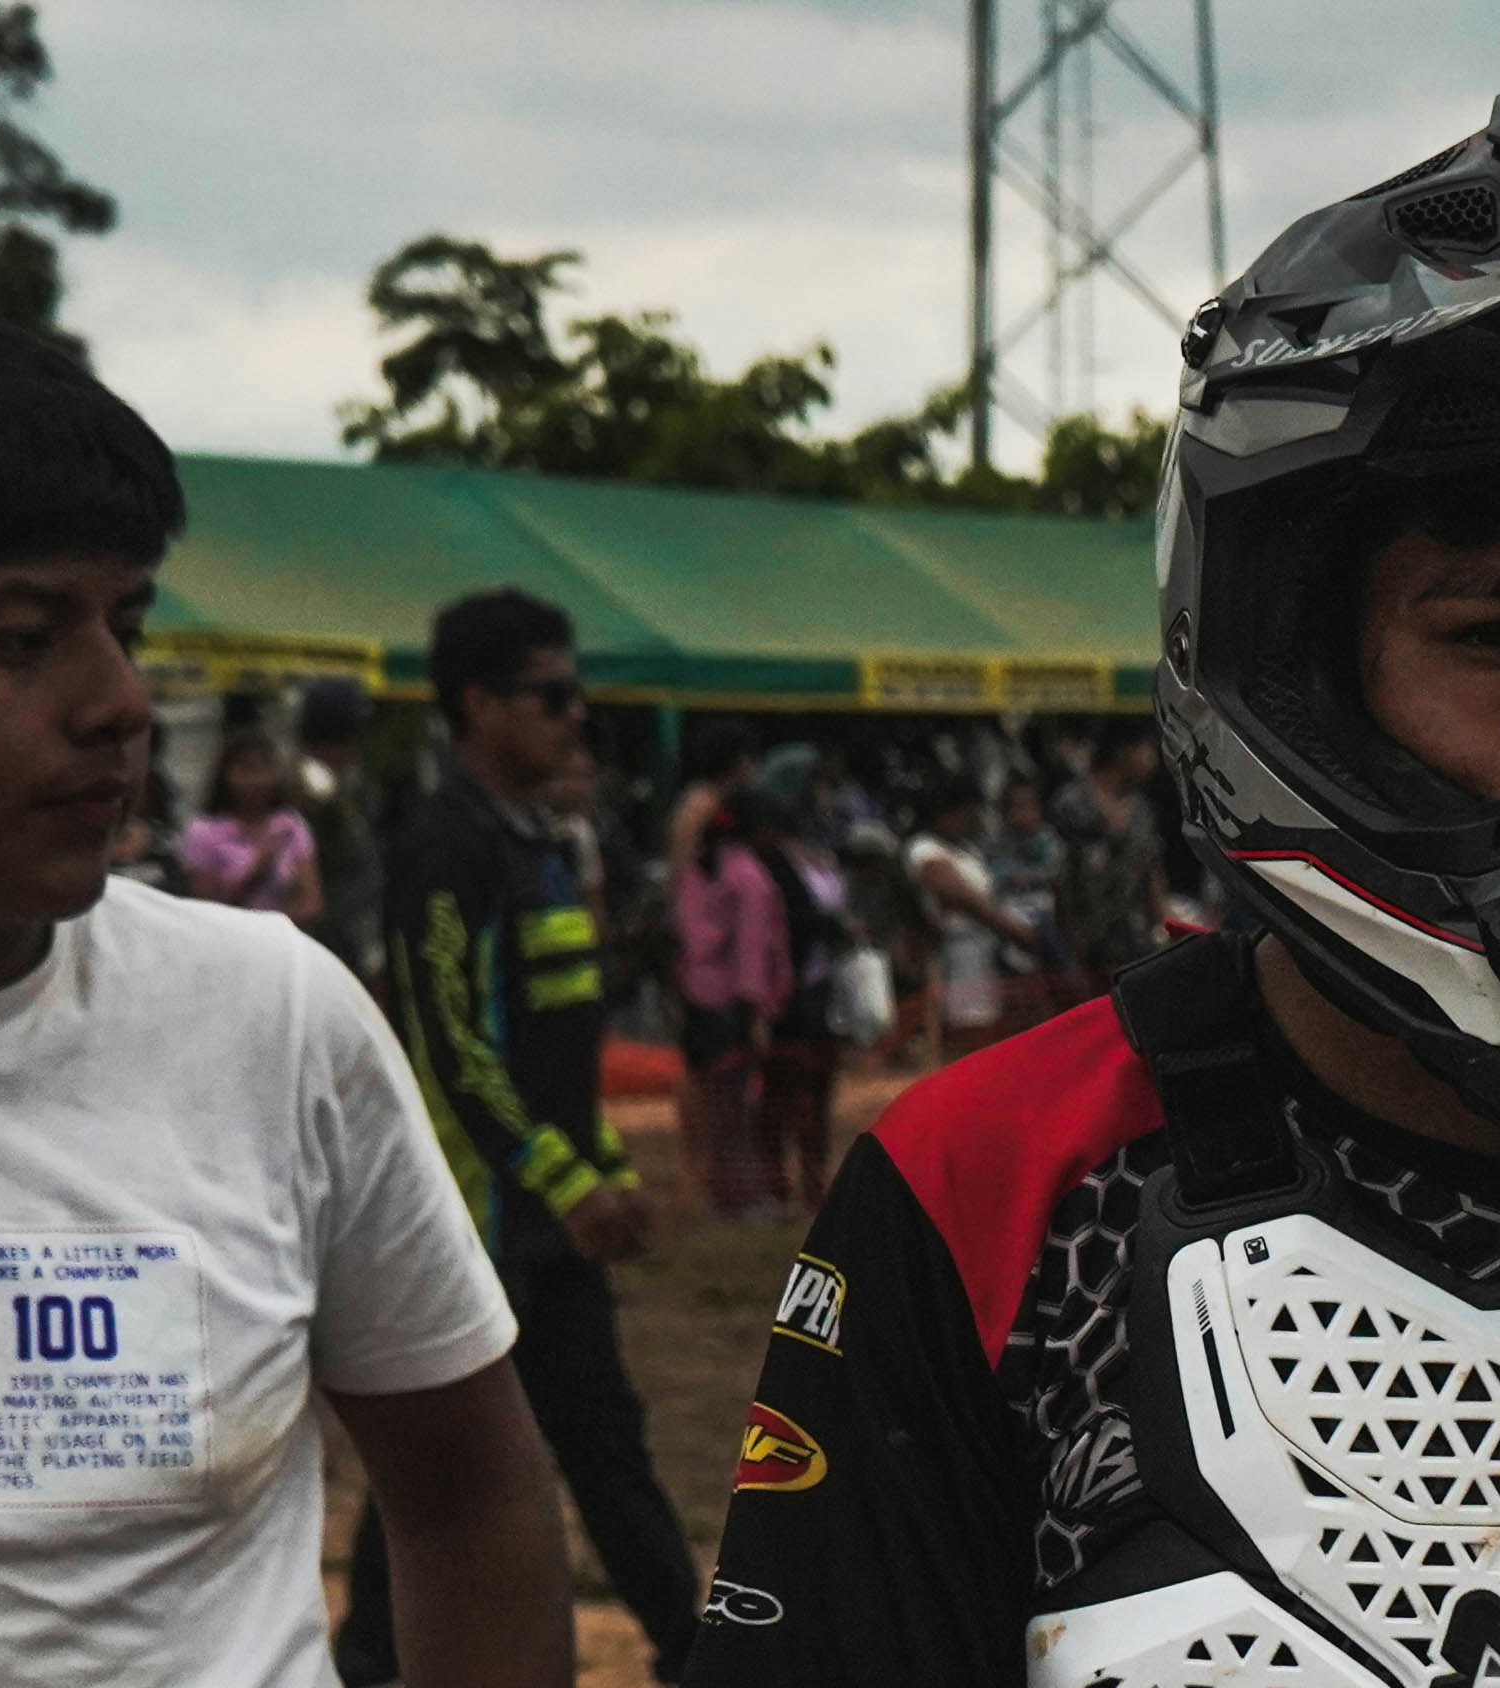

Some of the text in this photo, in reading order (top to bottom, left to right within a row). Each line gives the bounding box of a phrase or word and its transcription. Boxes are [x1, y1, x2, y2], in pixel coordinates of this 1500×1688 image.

[65, 1245, 124, 1261] LITTLE
[54, 1265, 140, 1281] CHAMPION
[12, 1293, 118, 1362] 100
[64, 1374, 149, 1390] CHAMPION
[2, 1394, 77, 1410] MAKING
[44, 1433, 106, 1450] USAGE
[42, 1453, 126, 1469] PLAYING
